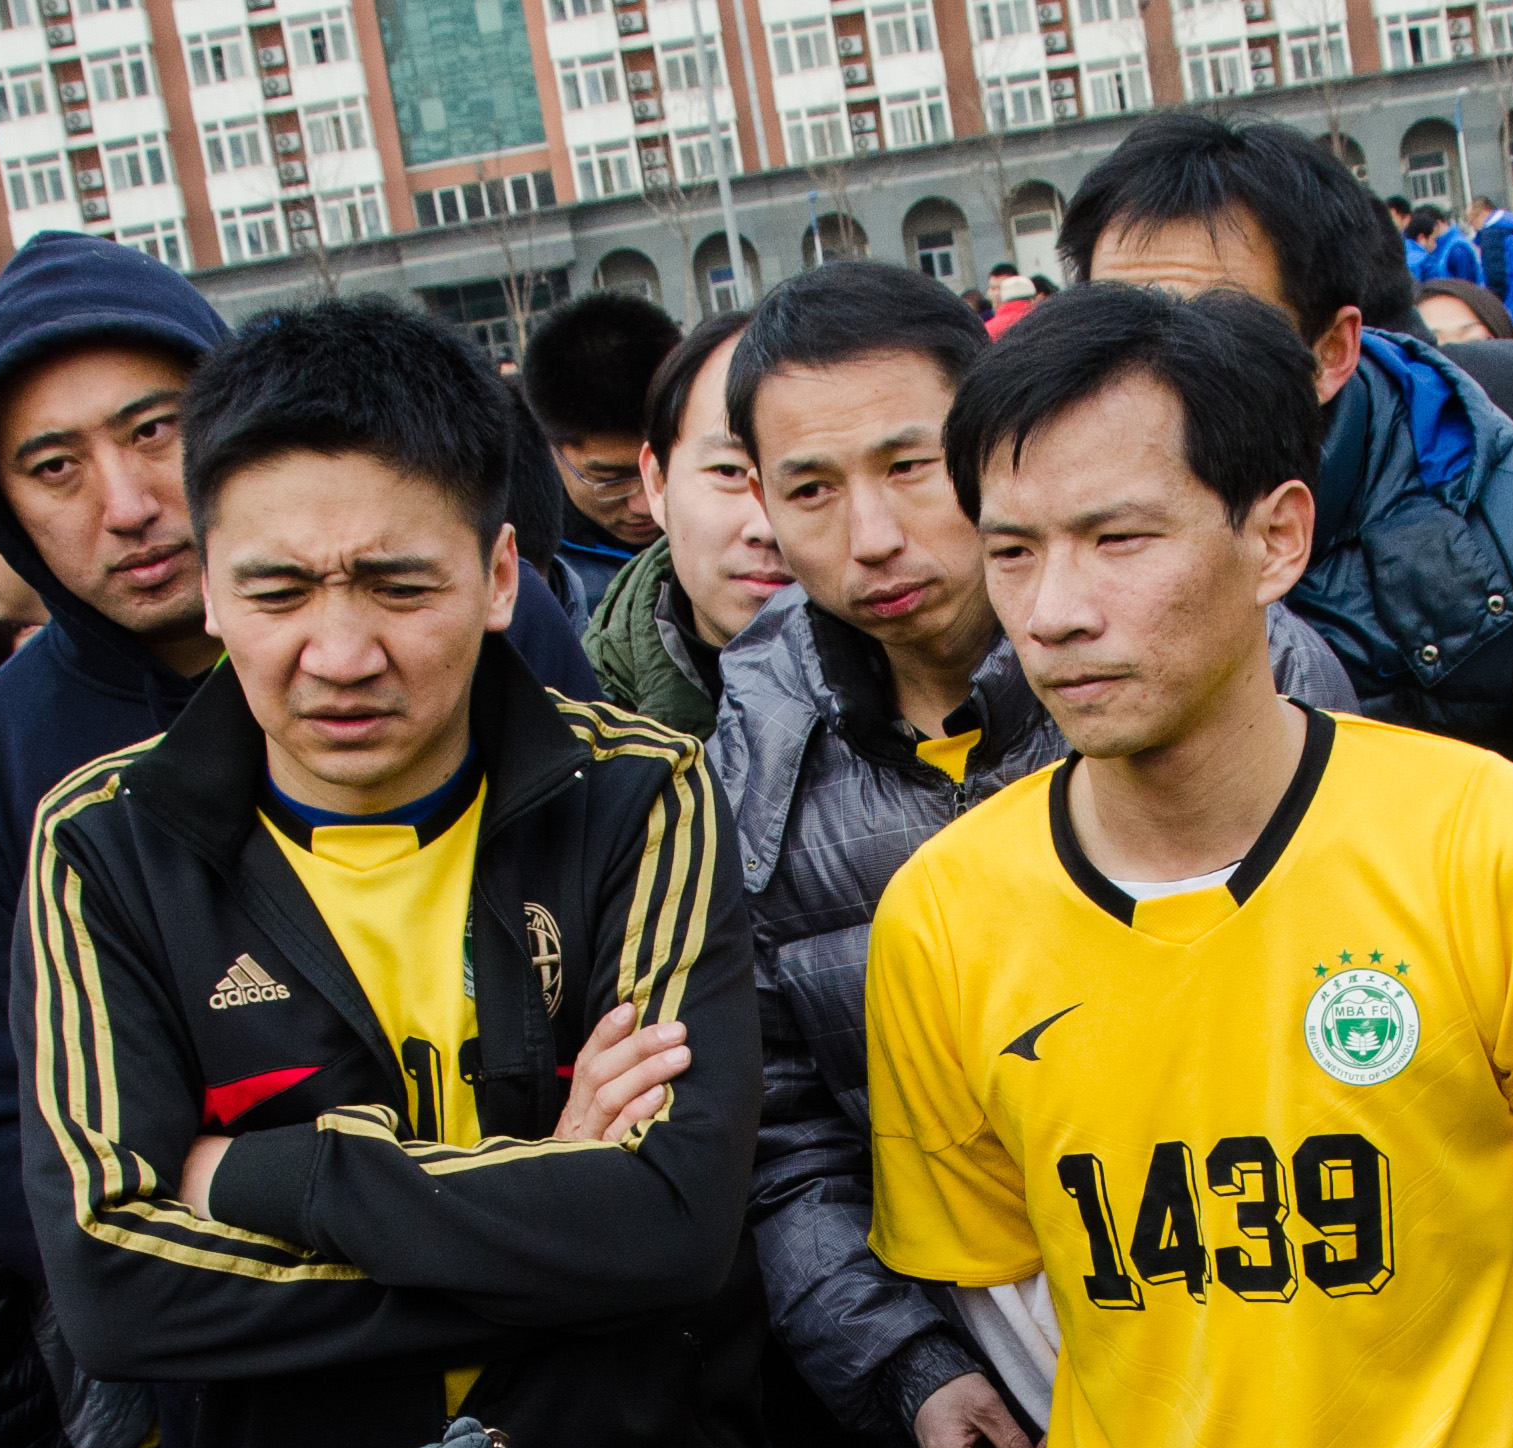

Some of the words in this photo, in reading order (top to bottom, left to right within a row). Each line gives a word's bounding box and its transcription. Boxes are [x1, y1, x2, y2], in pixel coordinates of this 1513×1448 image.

[209, 984, 291, 1010] adidas
[1335, 1006, 1365, 1016] MBA
[1372, 1006, 1389, 1016] FC
[1309, 1025, 1323, 1060] BEIJING
[1323, 1060, 1365, 1081] INSTITUTE
[1368, 1073, 1381, 1081] OF
[1382, 1023, 1416, 1075] TECHNOLOGY
[1057, 1134, 1395, 1311] 1439
